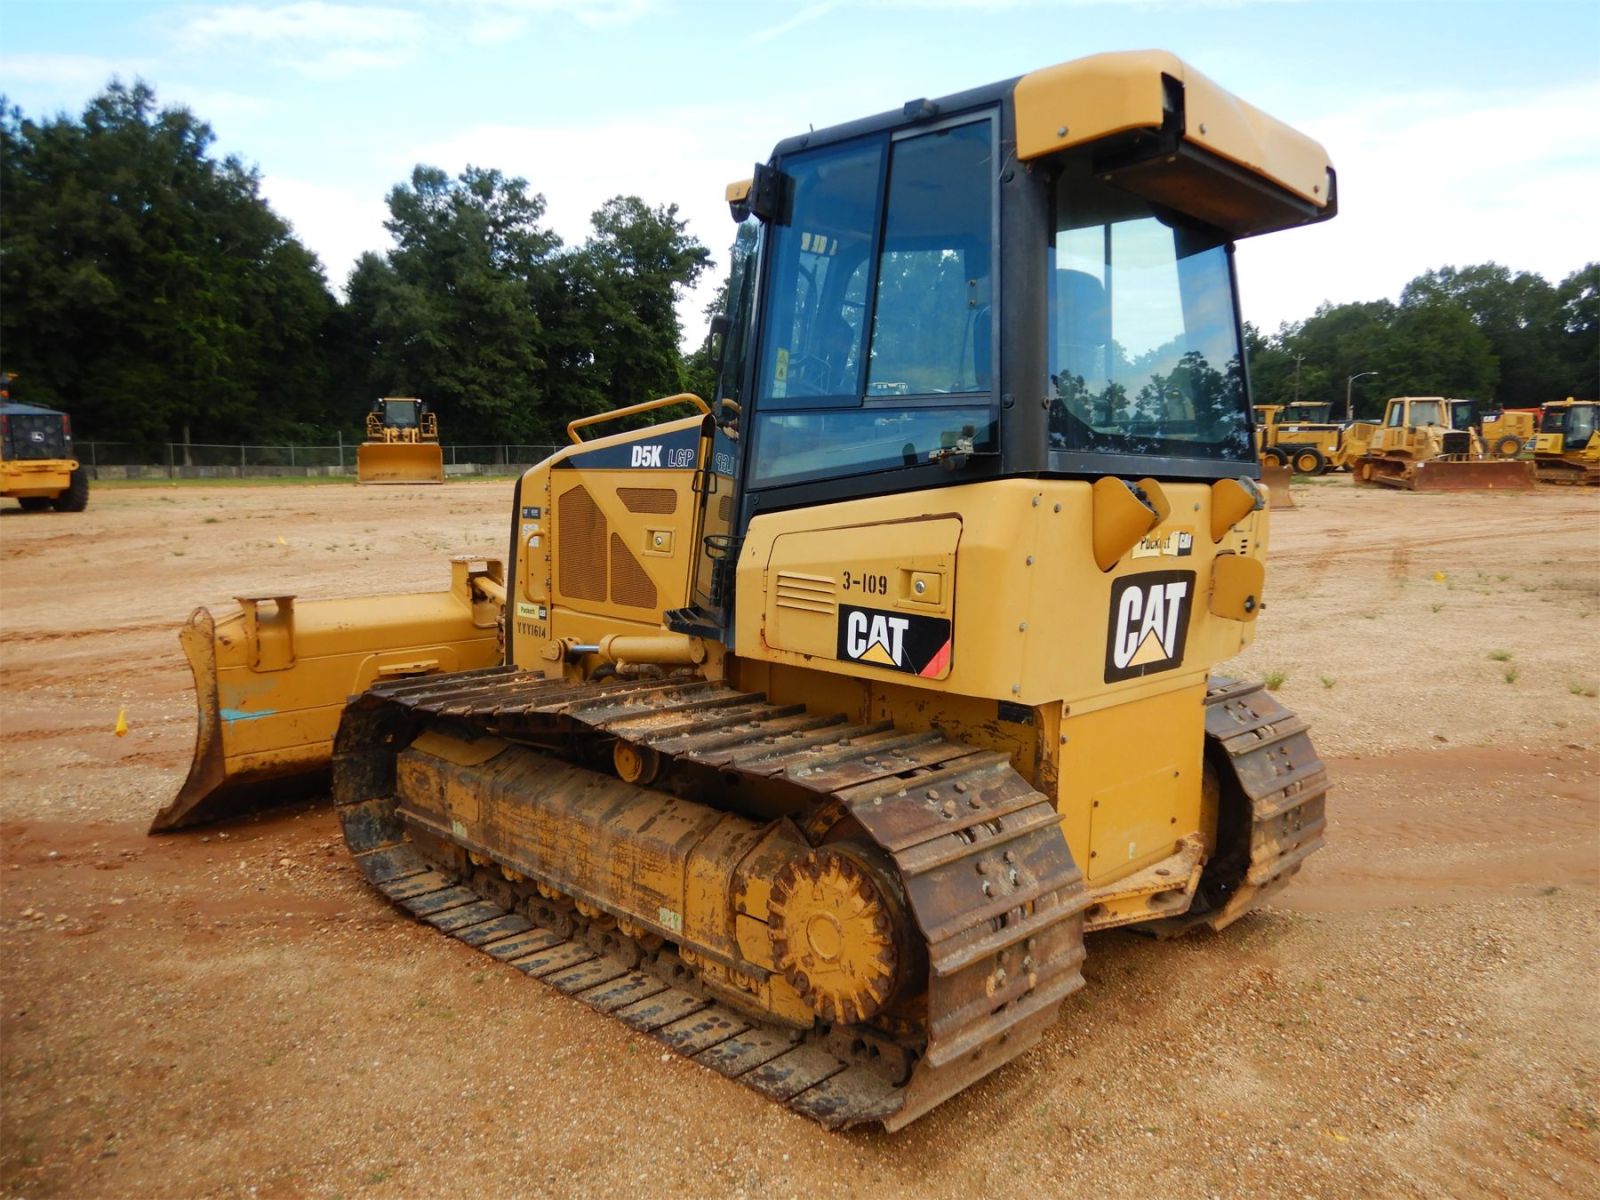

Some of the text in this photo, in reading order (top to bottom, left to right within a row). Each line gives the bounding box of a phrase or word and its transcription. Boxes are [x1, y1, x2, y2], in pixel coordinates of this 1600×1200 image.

[631, 445, 695, 468] D5K LGP
[842, 571, 888, 595] 3-109
[517, 622, 547, 639] YYY1614
[1113, 581, 1188, 669] CAT
[847, 610, 909, 667] CAT
